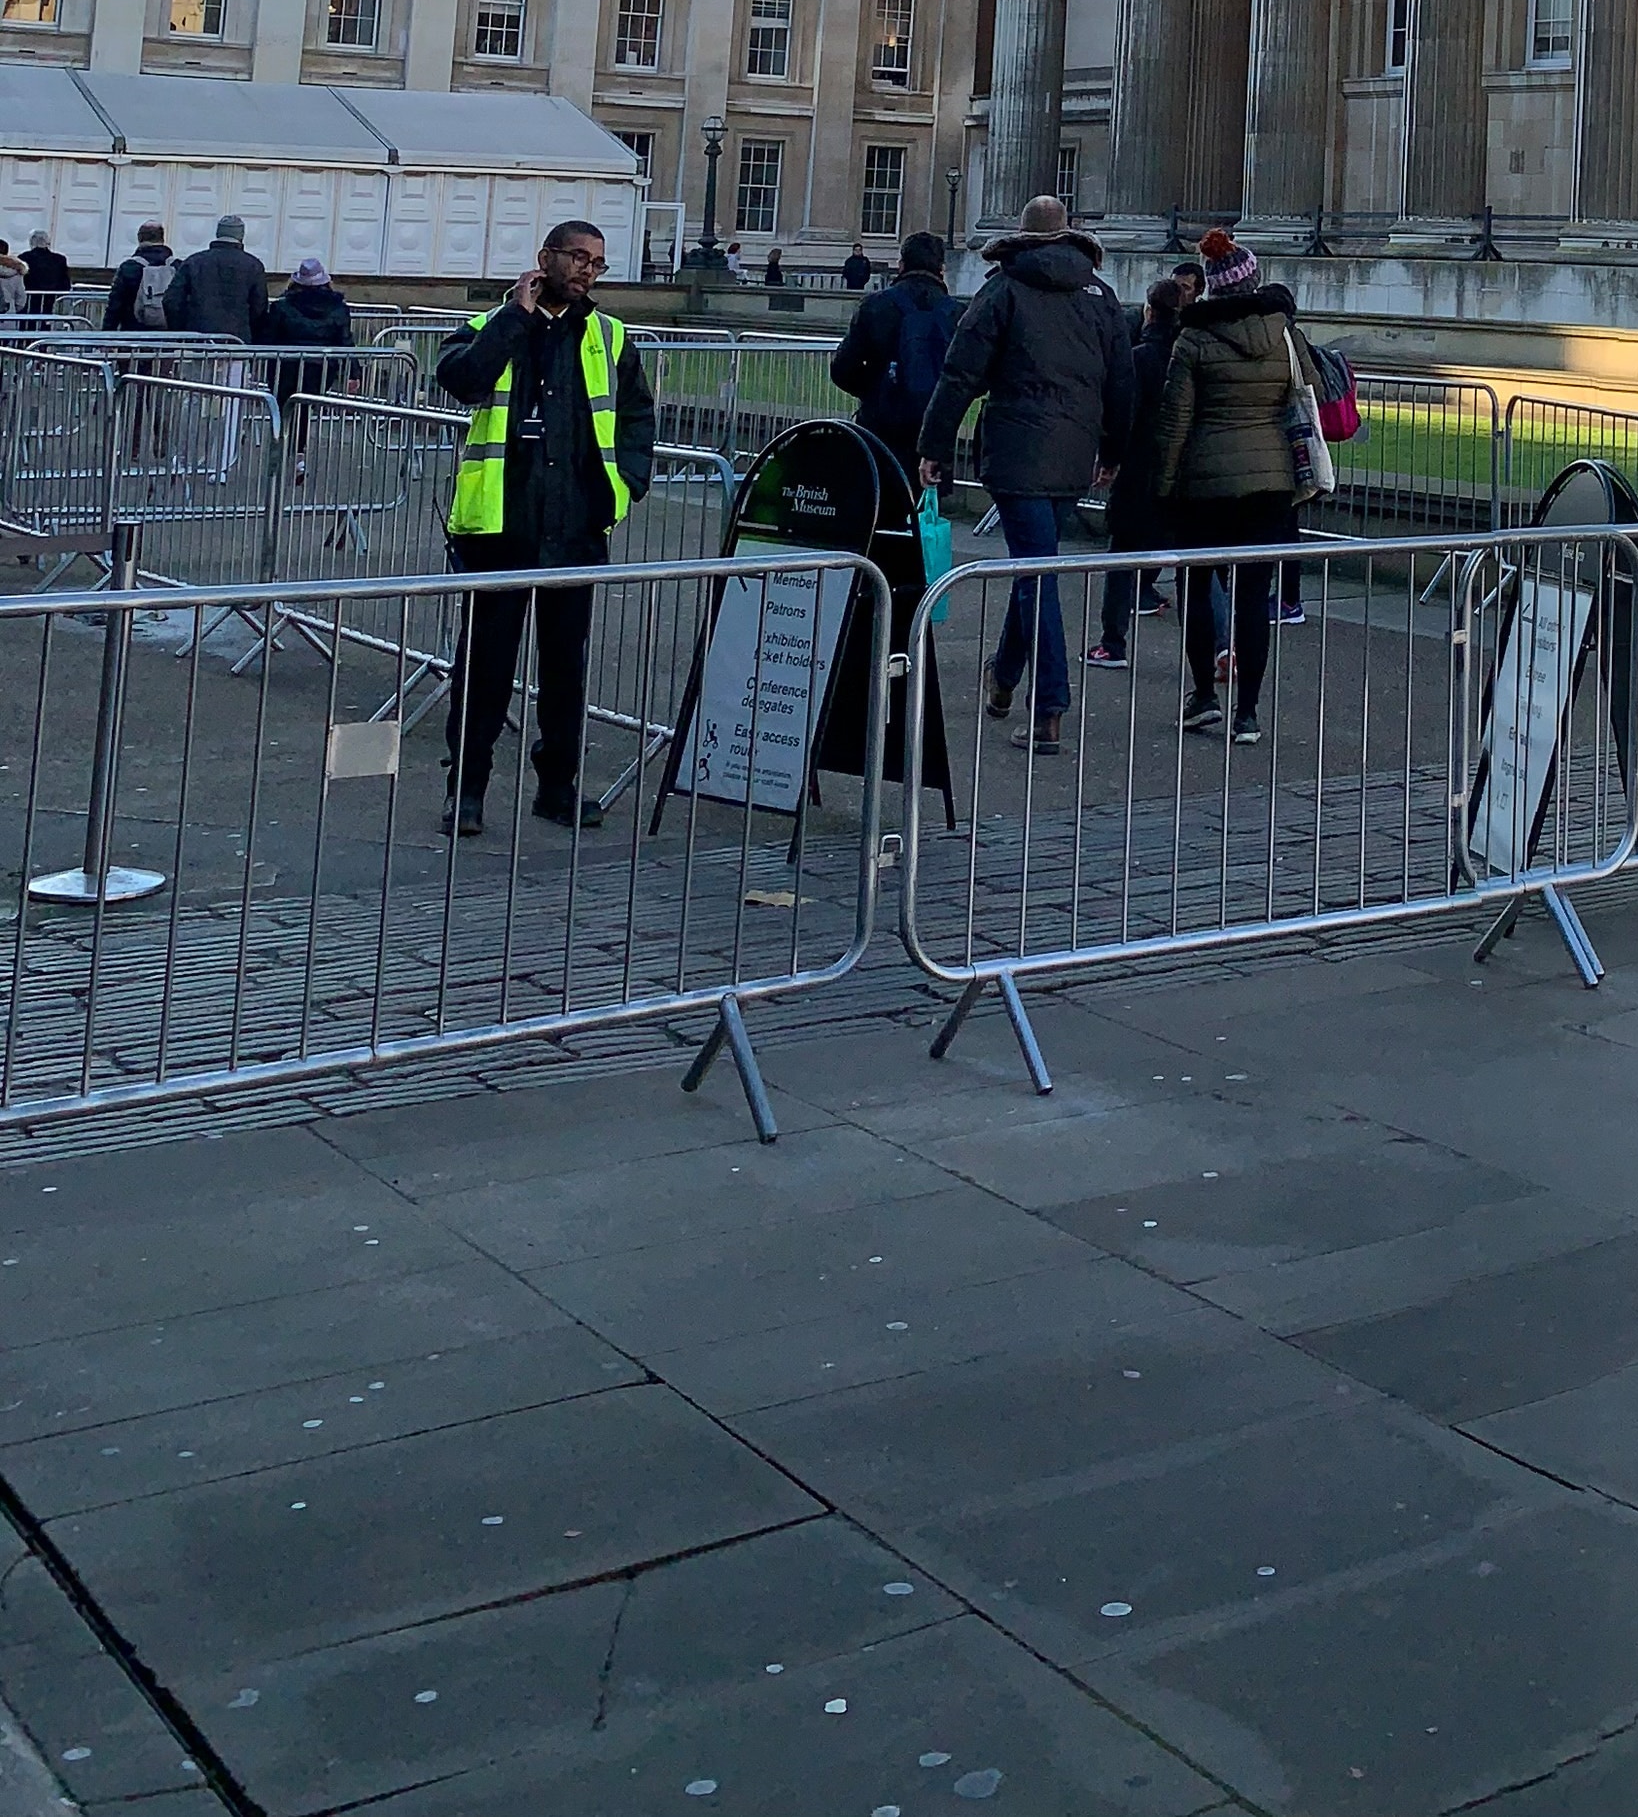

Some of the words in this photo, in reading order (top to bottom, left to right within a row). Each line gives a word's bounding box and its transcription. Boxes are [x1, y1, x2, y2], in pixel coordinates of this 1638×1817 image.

[782, 486, 795, 497] The
[796, 484, 829, 502] British
[791, 497, 836, 516] Museum
[766, 601, 806, 618] Patrons
[764, 631, 810, 649] xhibition
[746, 677, 808, 699] Cnference
[742, 695, 794, 715] deegates
[762, 731, 800, 747] access
[730, 744, 759, 757] rou
